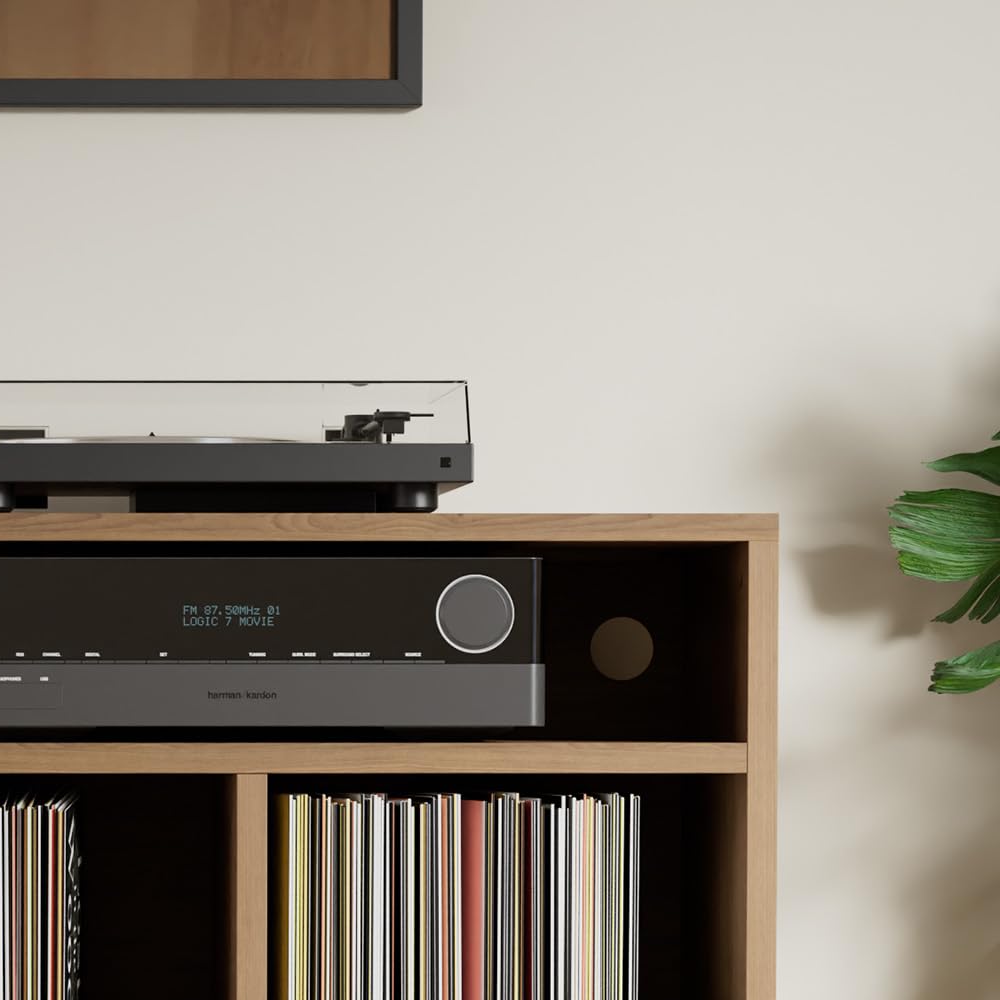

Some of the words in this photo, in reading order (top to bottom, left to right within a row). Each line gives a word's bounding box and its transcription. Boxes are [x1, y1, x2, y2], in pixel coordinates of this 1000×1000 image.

[183, 605, 197, 615] FM
[204, 605, 260, 615] 87.50MHz
[267, 605, 280, 615] 01
[183, 616, 218, 626] LOGIC
[225, 616, 232, 626] 7
[239, 616, 274, 626] MOVIE
